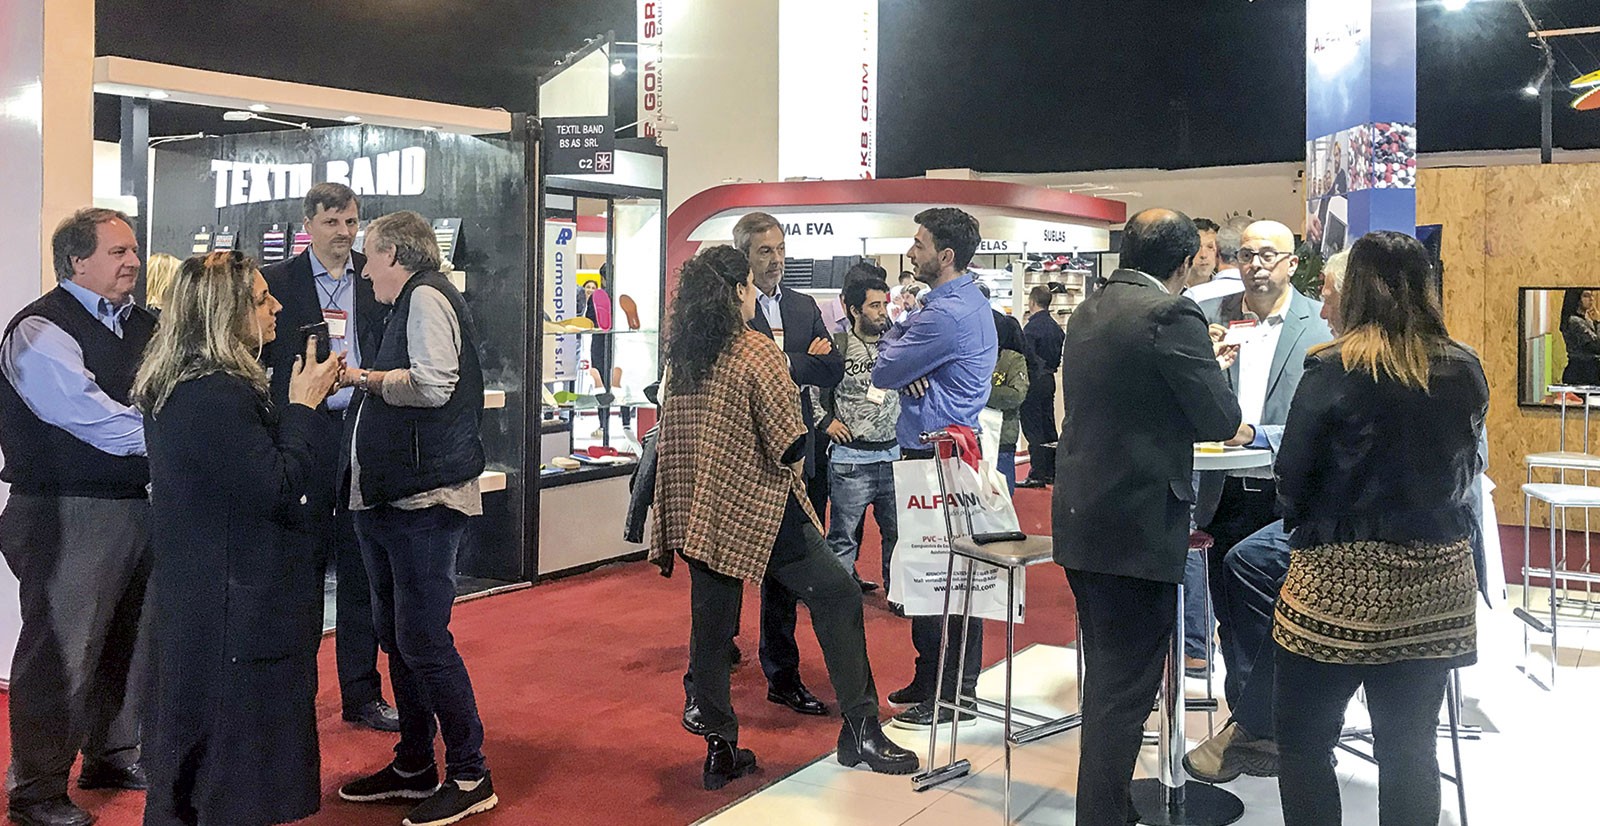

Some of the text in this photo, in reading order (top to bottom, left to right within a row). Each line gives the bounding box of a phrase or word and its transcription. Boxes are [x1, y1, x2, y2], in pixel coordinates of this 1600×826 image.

[860, 63, 869, 167] KB GOM
[556, 124, 604, 135] TEXTIL BAND
[560, 138, 599, 149] BS AS SRL
[578, 159, 593, 169] C2
[326, 146, 426, 196] BAND
[806, 222, 834, 235] EVA
[1044, 229, 1066, 243] SUELAS
[976, 240, 1008, 251] ELAS
[922, 535, 937, 543] PVC
